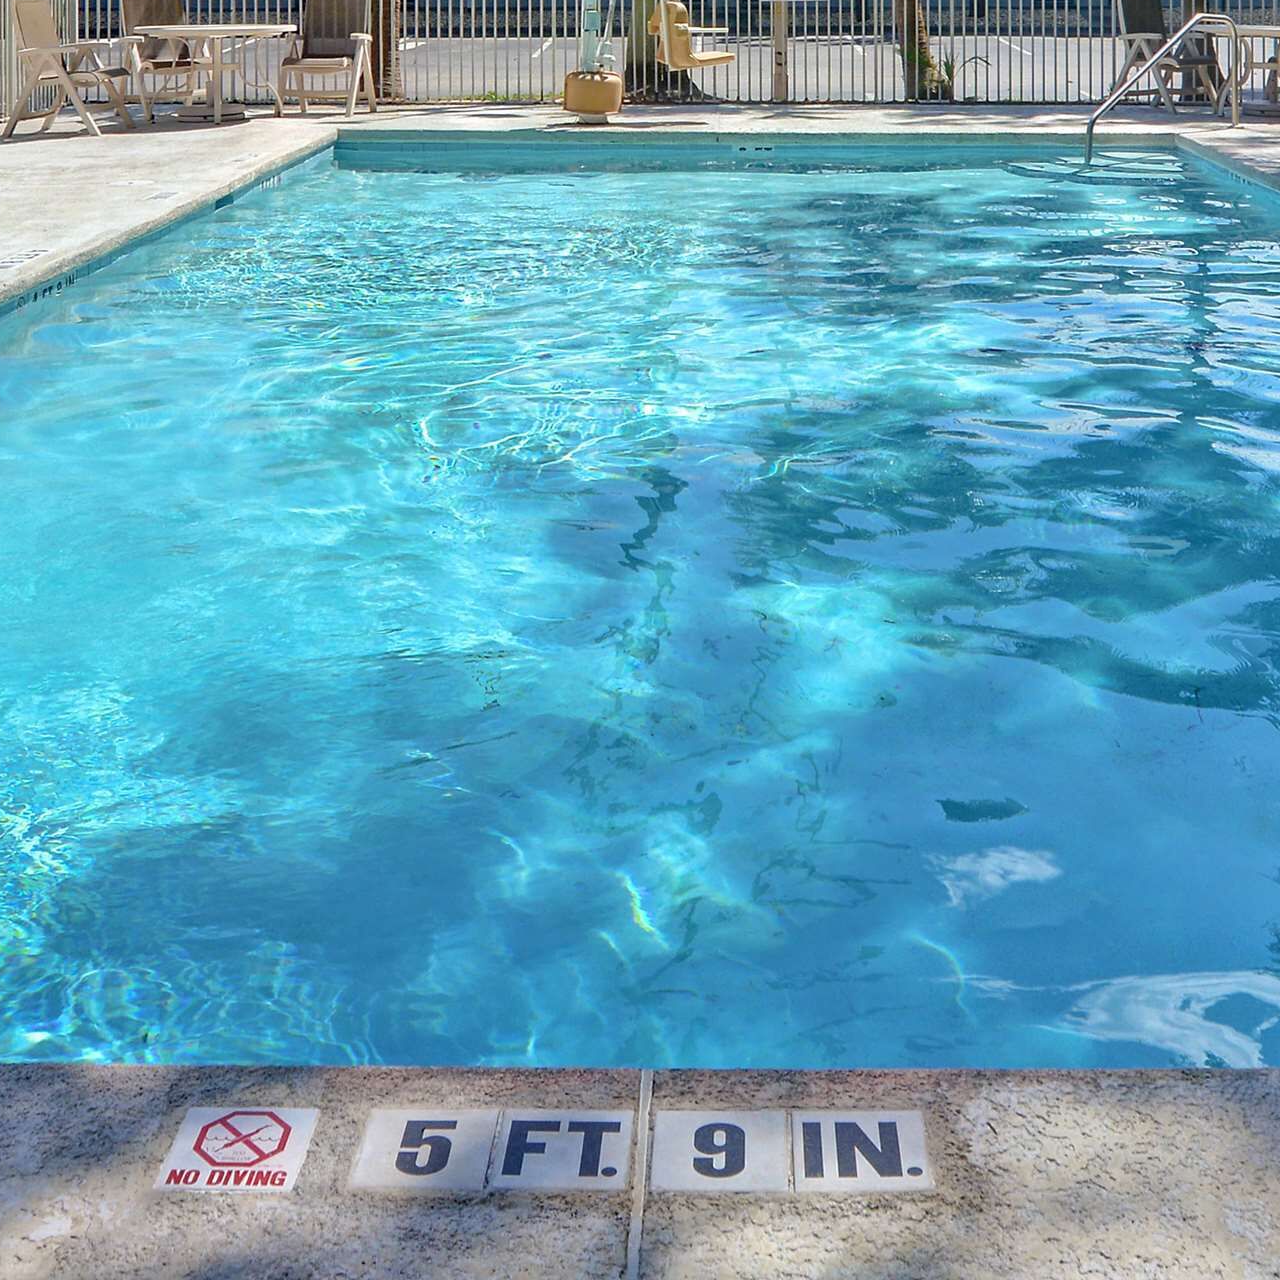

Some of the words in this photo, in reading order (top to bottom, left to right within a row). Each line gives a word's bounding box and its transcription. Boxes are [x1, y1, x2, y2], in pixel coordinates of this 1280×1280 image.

[394, 1120, 458, 1177] 5
[500, 1120, 622, 1178] FT.
[692, 1121, 747, 1178] 9
[802, 1121, 924, 1178] IN.
[165, 1169, 200, 1185] NO
[206, 1169, 288, 1186] DIVING
